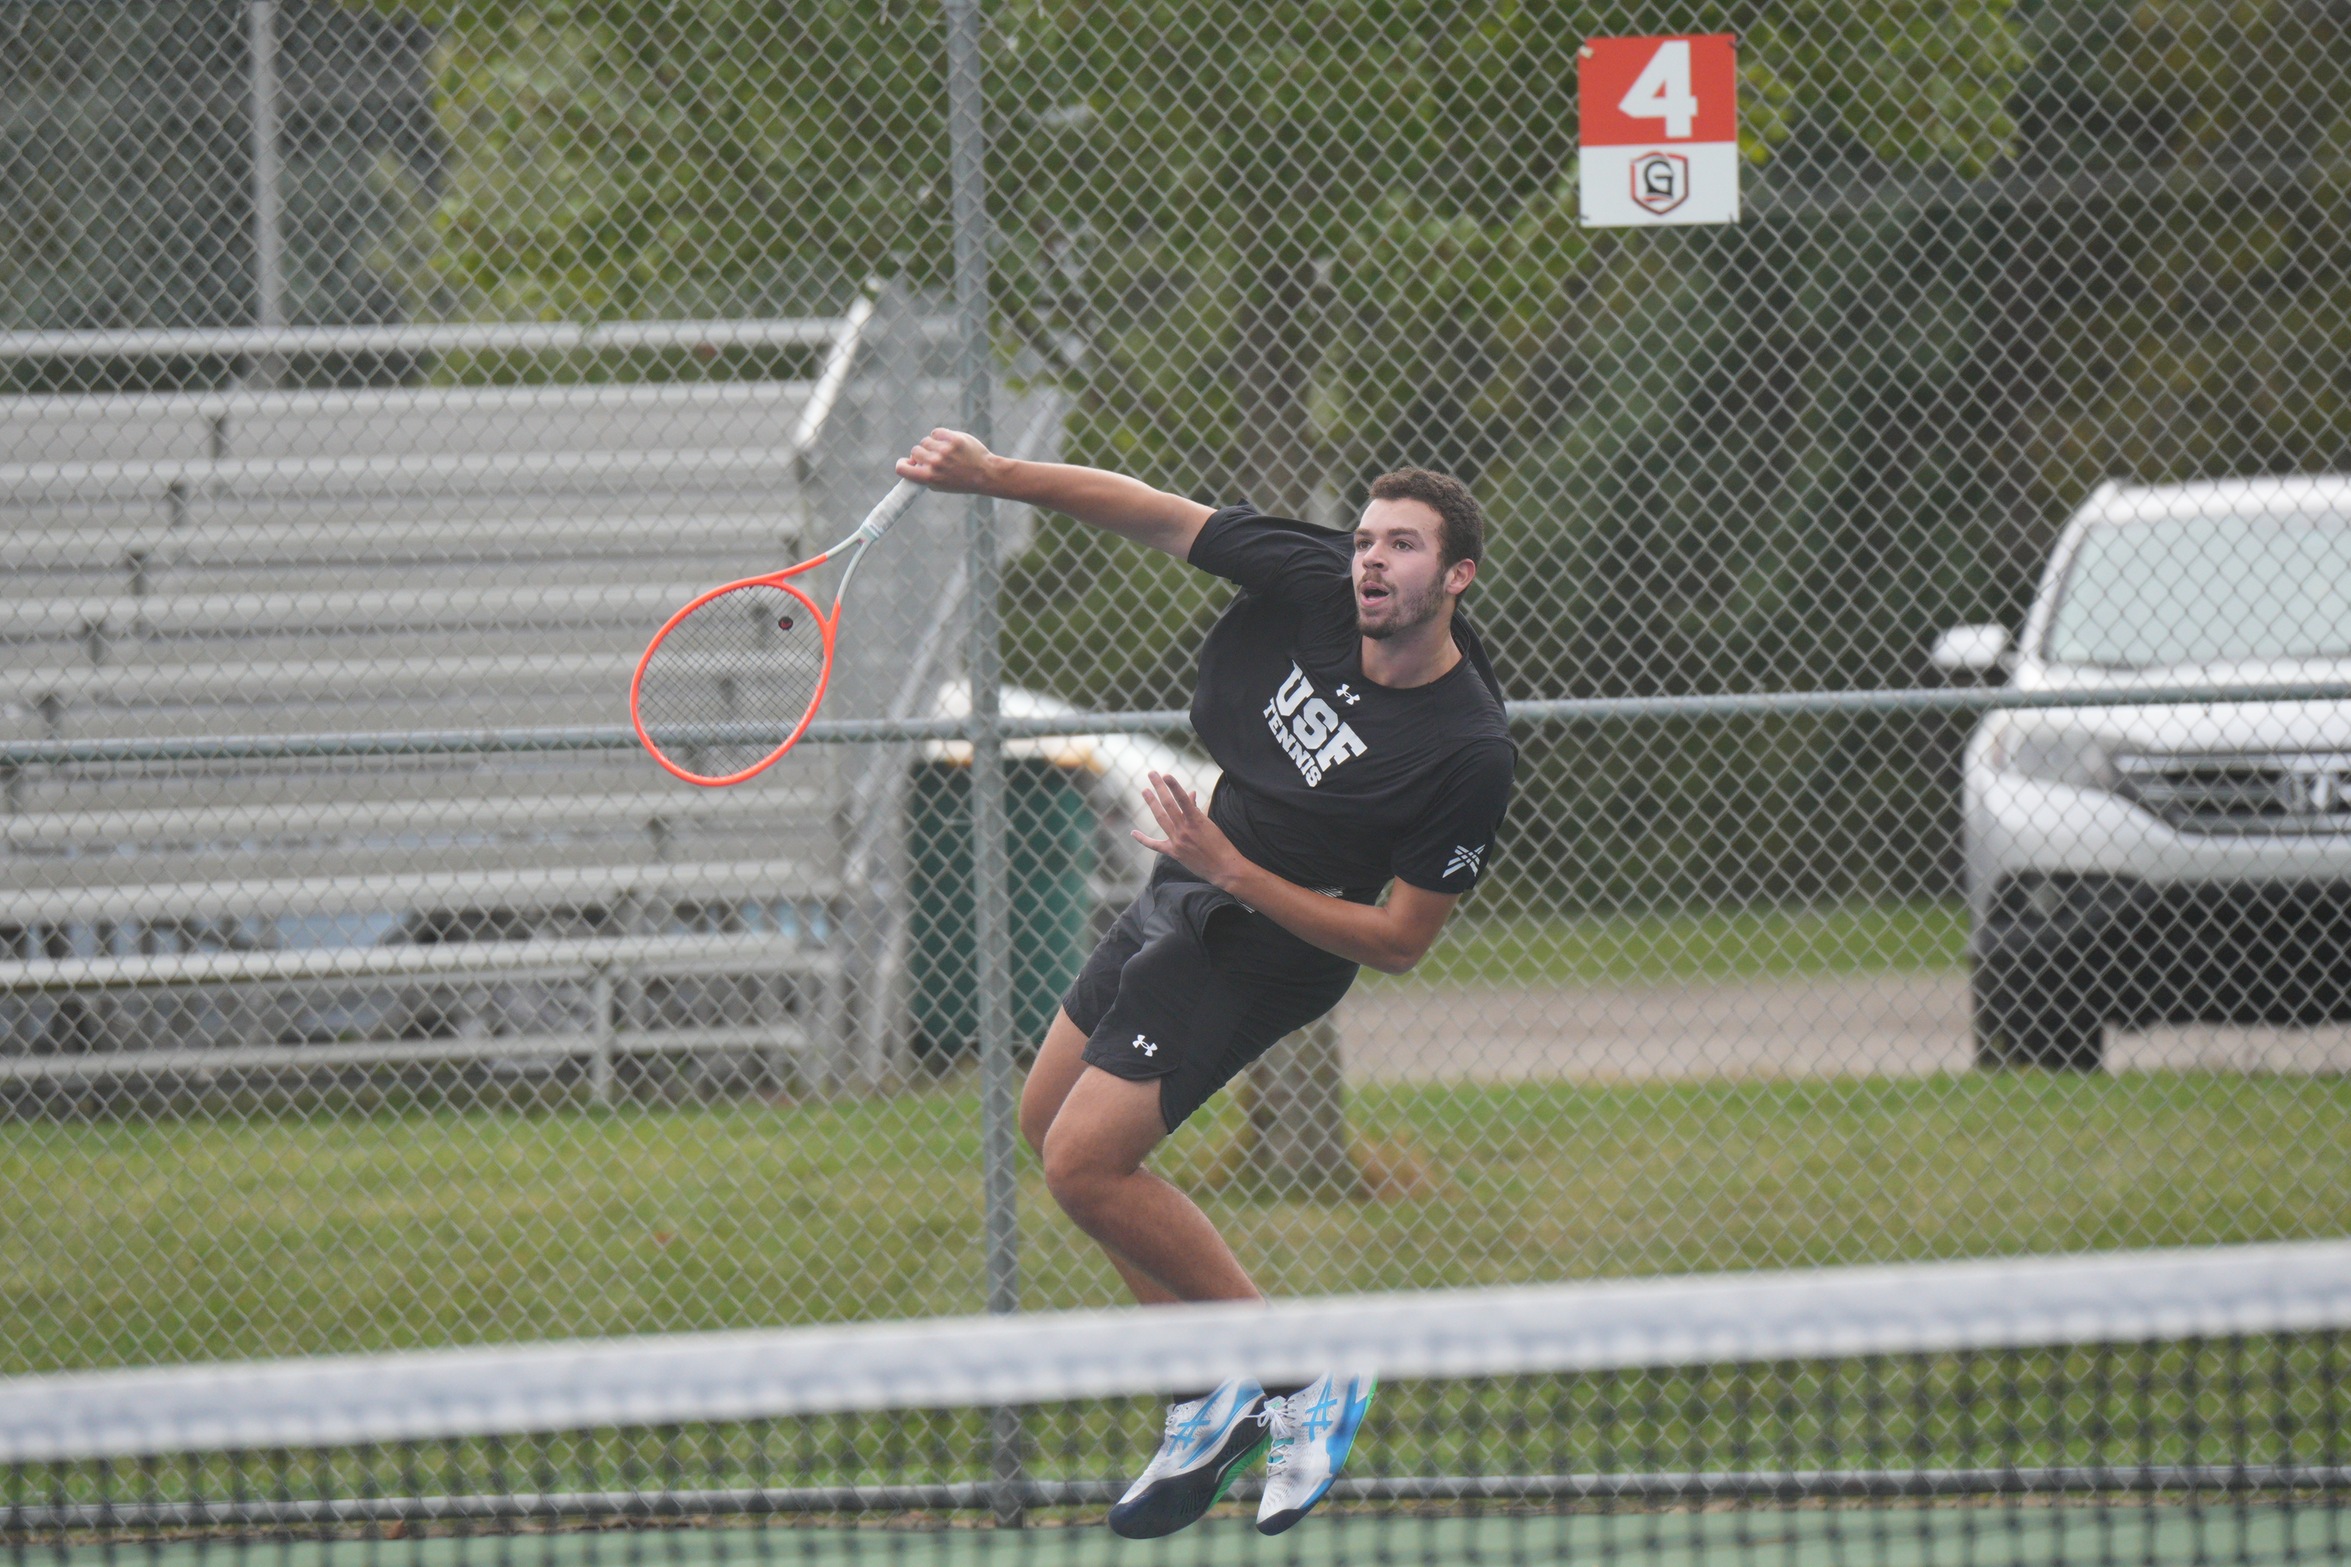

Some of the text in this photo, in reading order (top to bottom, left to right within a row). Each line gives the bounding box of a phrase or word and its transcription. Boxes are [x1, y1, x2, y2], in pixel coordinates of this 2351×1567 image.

[1618, 40, 1698, 139] 4
[1262, 696, 1322, 788] TENNIS
[1275, 658, 1368, 772] USF
